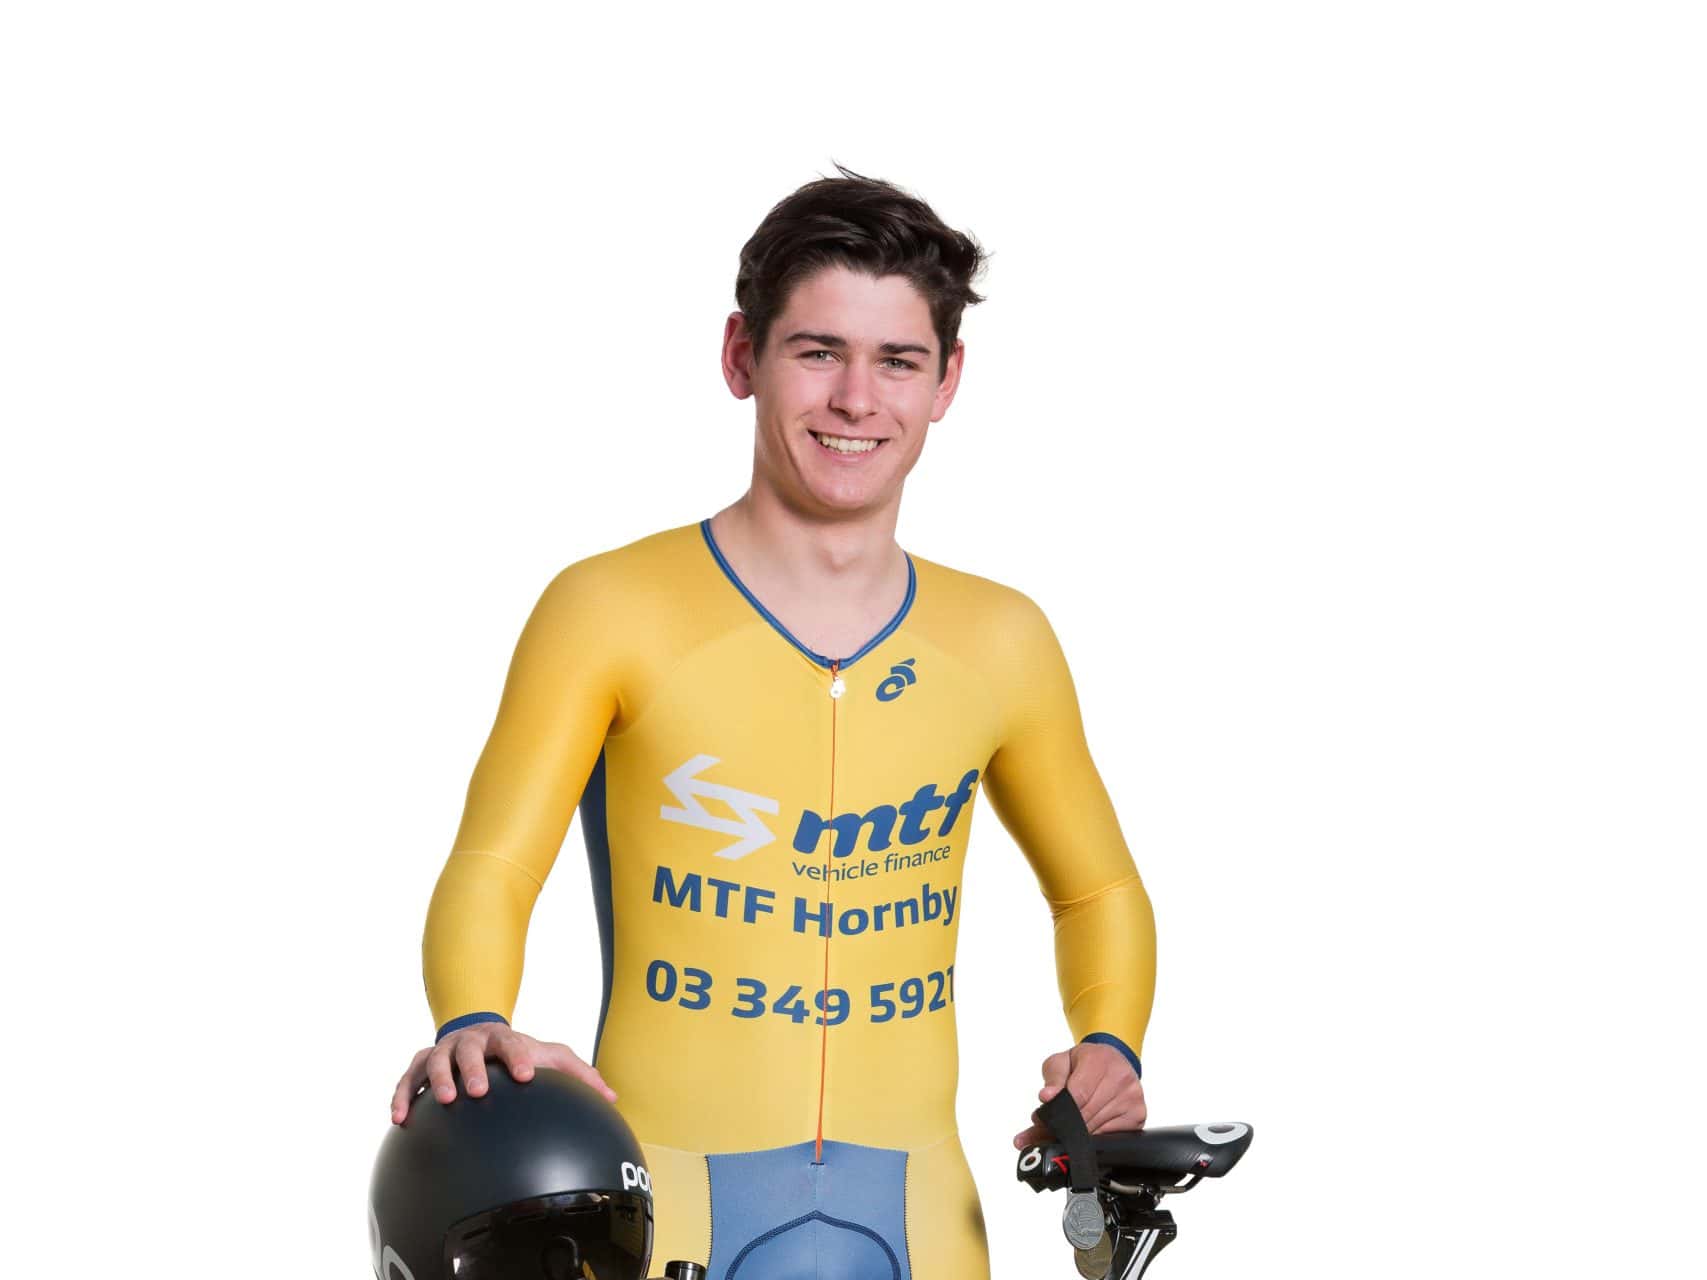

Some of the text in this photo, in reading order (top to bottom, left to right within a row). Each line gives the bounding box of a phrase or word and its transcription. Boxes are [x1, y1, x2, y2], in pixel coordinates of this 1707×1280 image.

[793, 769, 979, 858] mtf
[792, 845, 950, 881] vehicle finance
[652, 866, 957, 937] MTF Hornby
[646, 960, 713, 1010] 03
[732, 977, 850, 1025] 349
